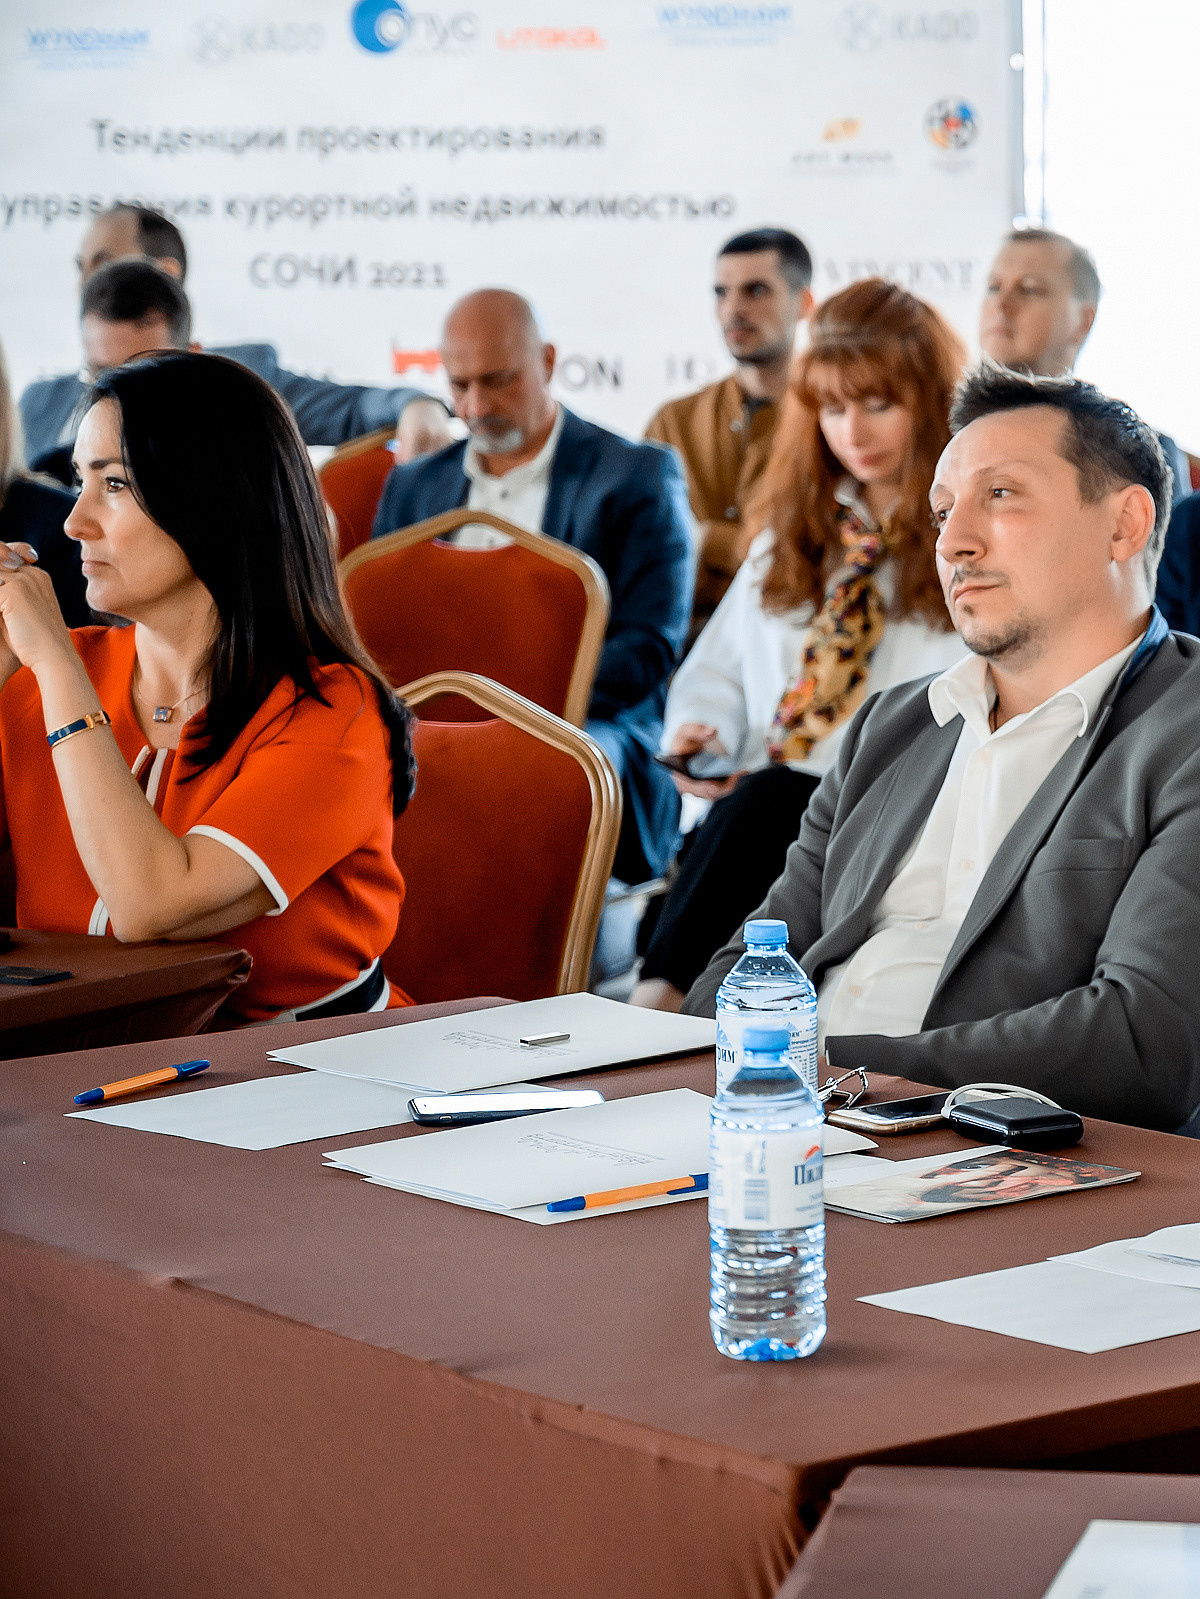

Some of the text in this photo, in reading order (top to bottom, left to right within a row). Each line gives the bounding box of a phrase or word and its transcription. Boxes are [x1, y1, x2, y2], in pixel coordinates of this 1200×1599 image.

[91, 118, 606, 160] Тенденции проектирования
[225, 185, 418, 228] курортной
[428, 192, 738, 226] недвижимостью
[248, 251, 448, 289] СОЧИ 2021
